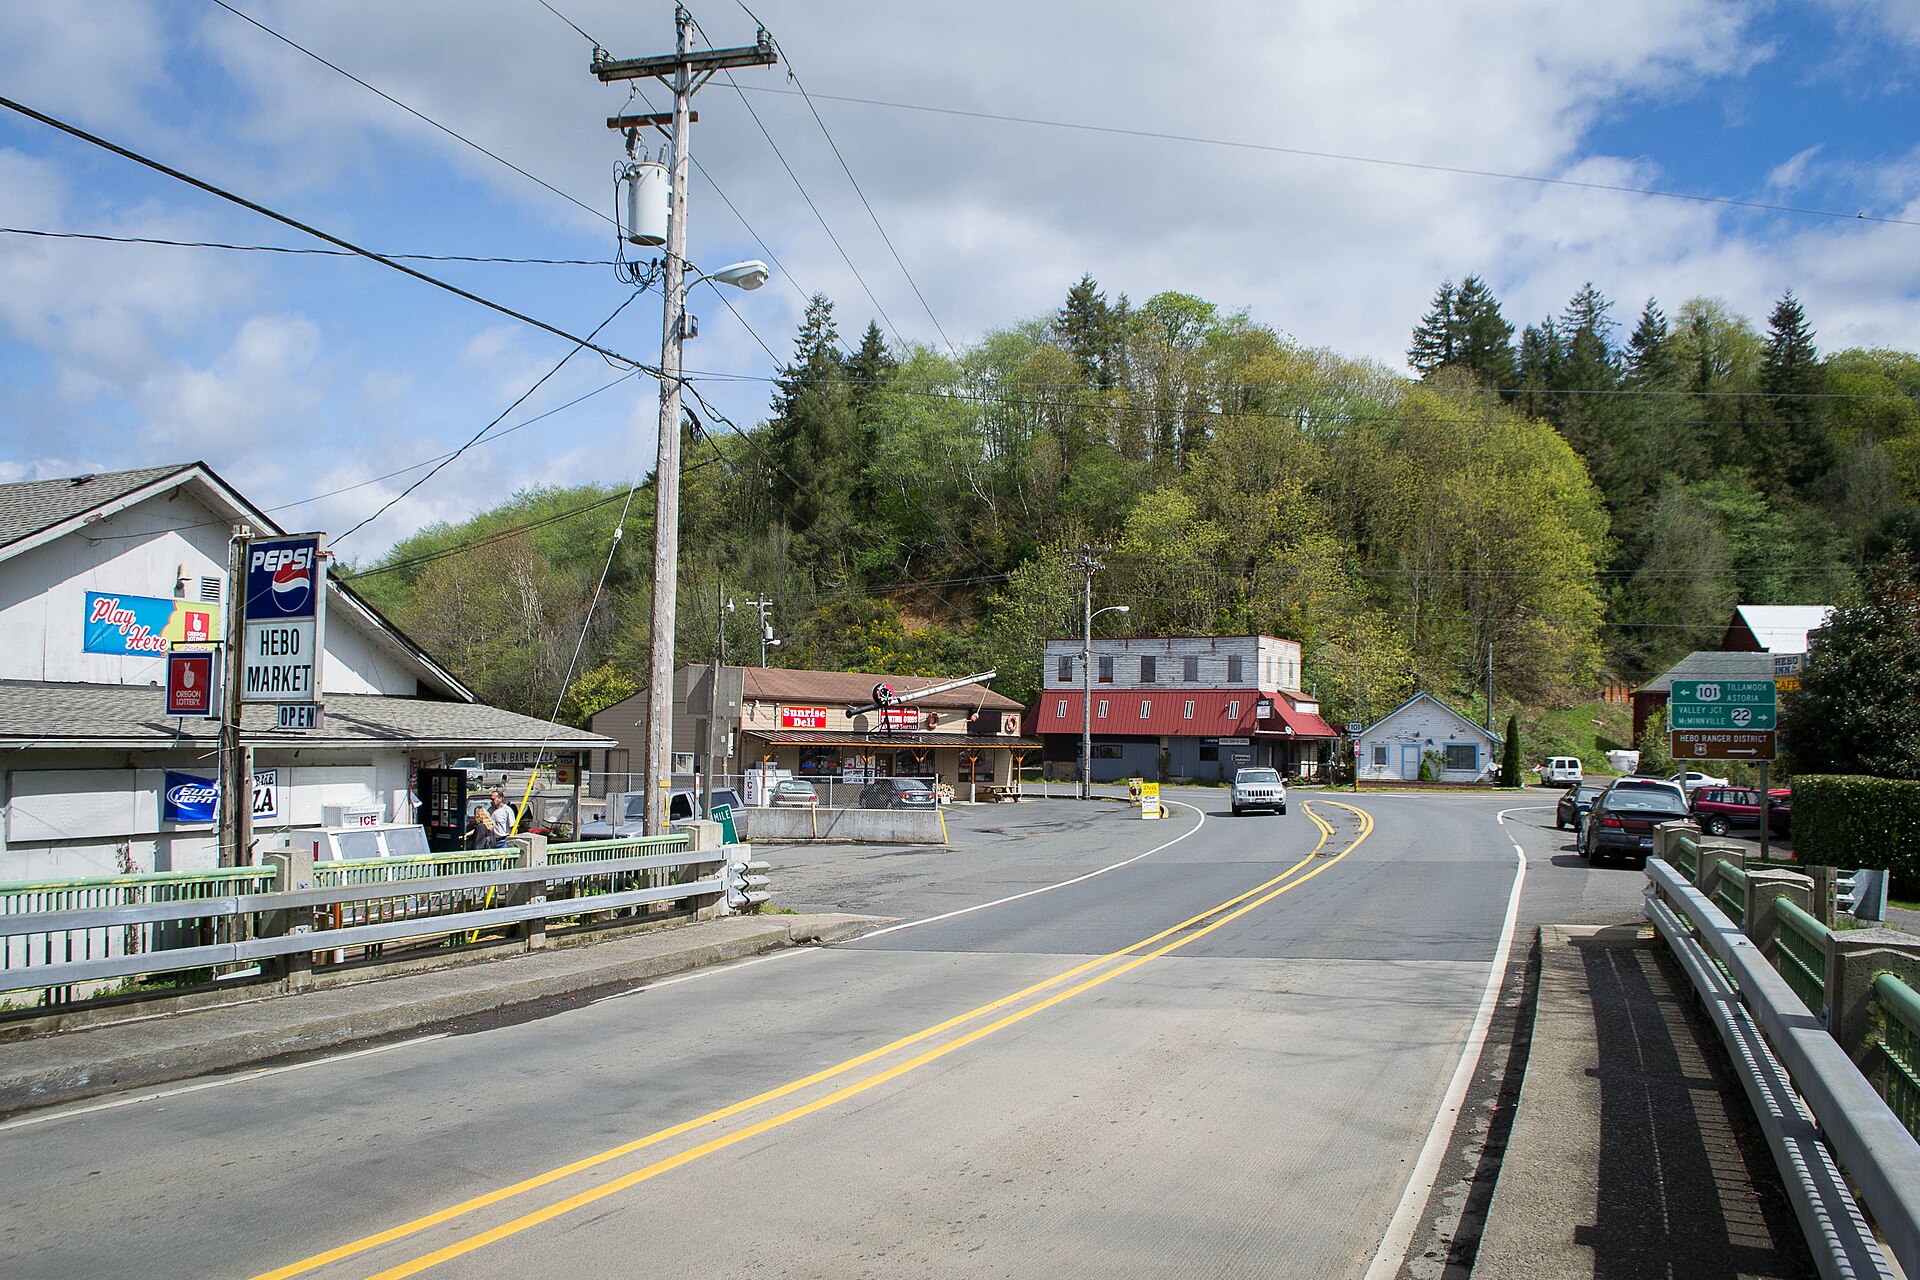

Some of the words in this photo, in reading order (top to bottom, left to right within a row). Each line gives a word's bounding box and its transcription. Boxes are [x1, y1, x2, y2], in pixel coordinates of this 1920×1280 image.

[251, 547, 314, 573] PEPSI
[90, 597, 135, 634] Play
[126, 625, 169, 652] Here
[260, 628, 300, 657] HEBO
[1775, 656, 1798, 665] HEBO
[1775, 666, 1791, 674] INN
[247, 664, 311, 693] MARKET
[176, 690, 201, 698] OREGON
[1699, 687, 1717, 698] 101
[1727, 683, 1768, 691] TILLAMOOK
[783, 707, 826, 718] Sunrise
[1678, 706, 1706, 714] VALLEY
[1732, 709, 1750, 721] 22
[281, 706, 315, 727] OPEN
[793, 717, 816, 727] Deli
[1678, 717, 1726, 725] McMINNVILLE
[180, 786, 216, 796] BUD
[175, 795, 219, 804] LIGHT
[359, 815, 377, 827] ICE
[713, 810, 731, 822] MILE
